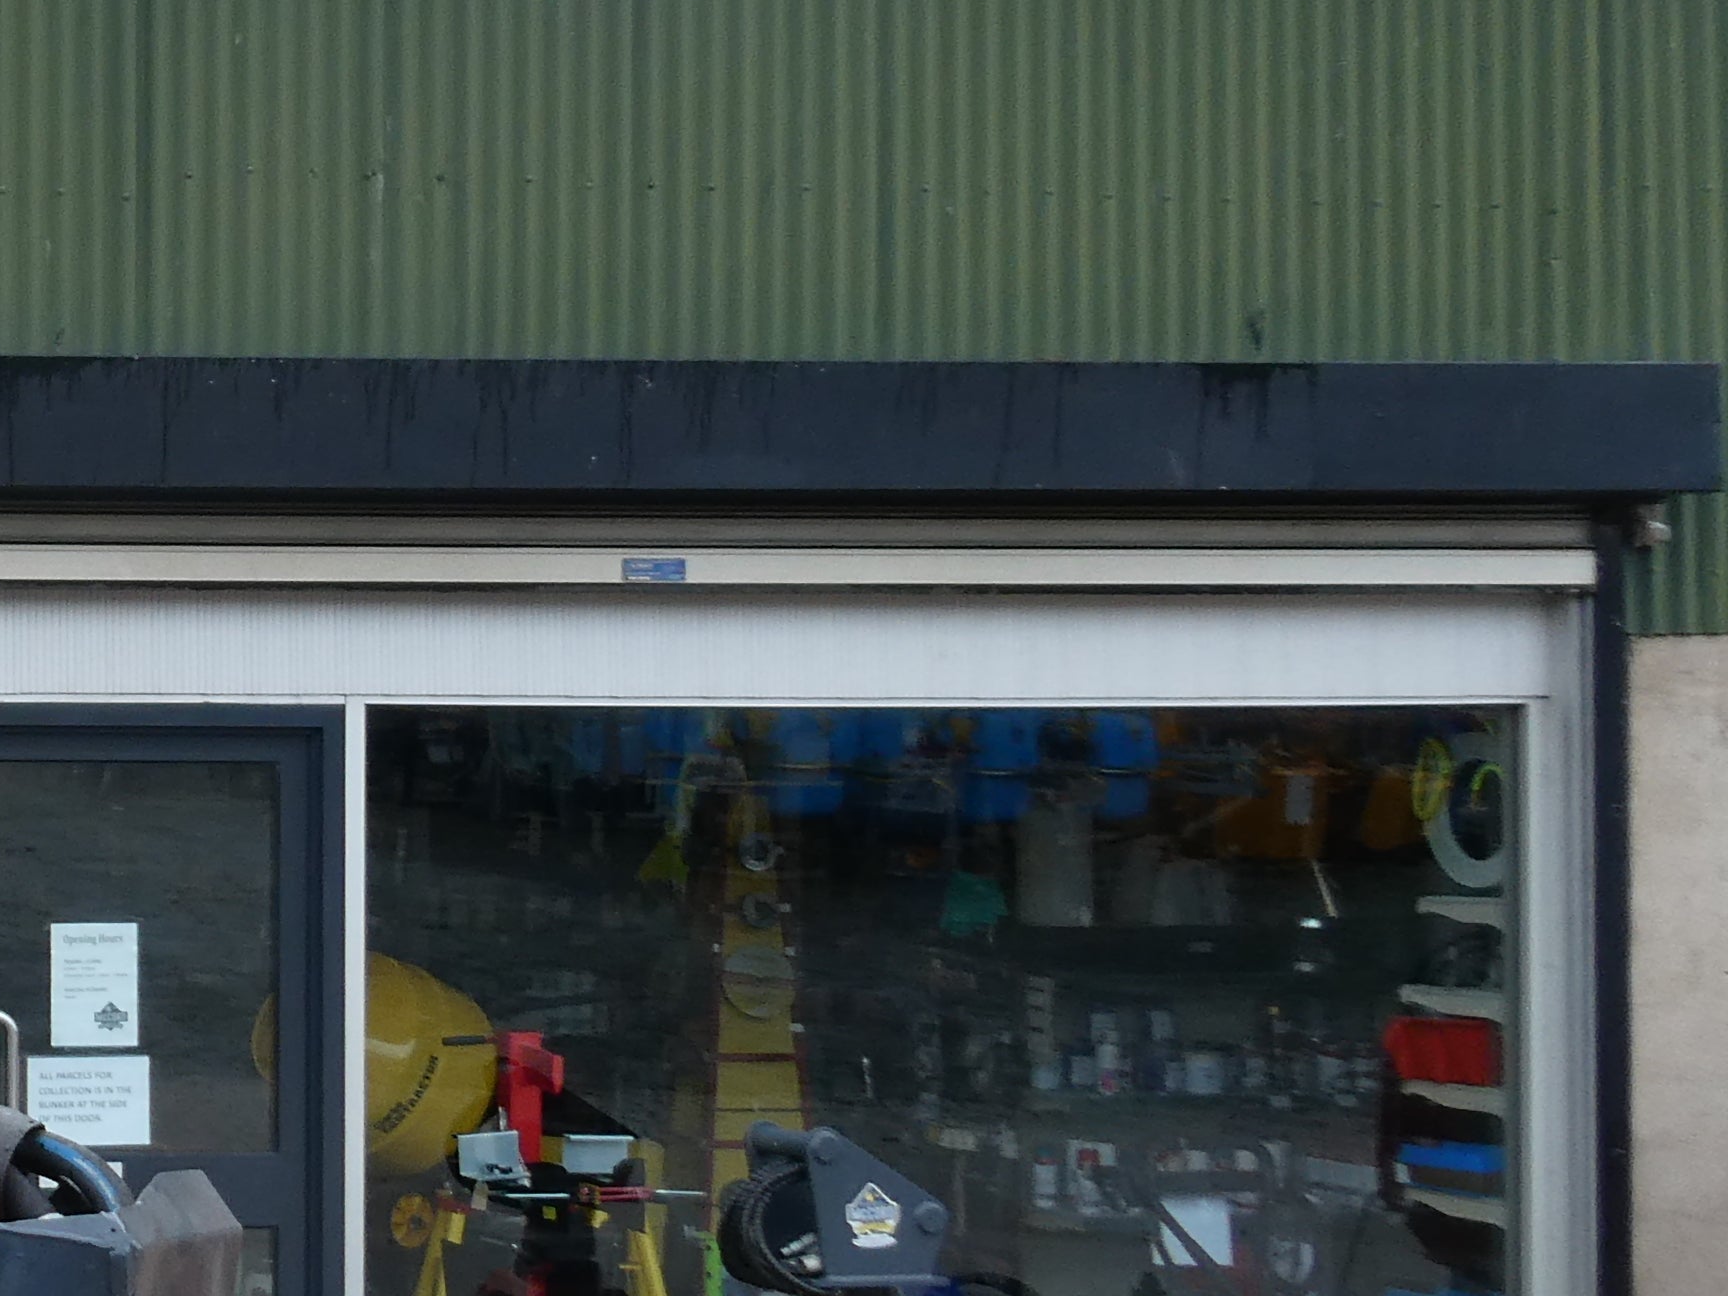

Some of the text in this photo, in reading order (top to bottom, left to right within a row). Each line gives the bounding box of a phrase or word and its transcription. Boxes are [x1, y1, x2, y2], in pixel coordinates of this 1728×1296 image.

[63, 933, 123, 946] Opening Hours
[56, 1071, 92, 1080] PARCELS
[95, 1071, 113, 1080] FOR
[38, 1086, 92, 1095] COLLECTION
[116, 1085, 132, 1094] THE
[38, 1100, 74, 1109] BUNKER
[90, 1100, 106, 1108] THE
[53, 1114, 72, 1122] THIS
